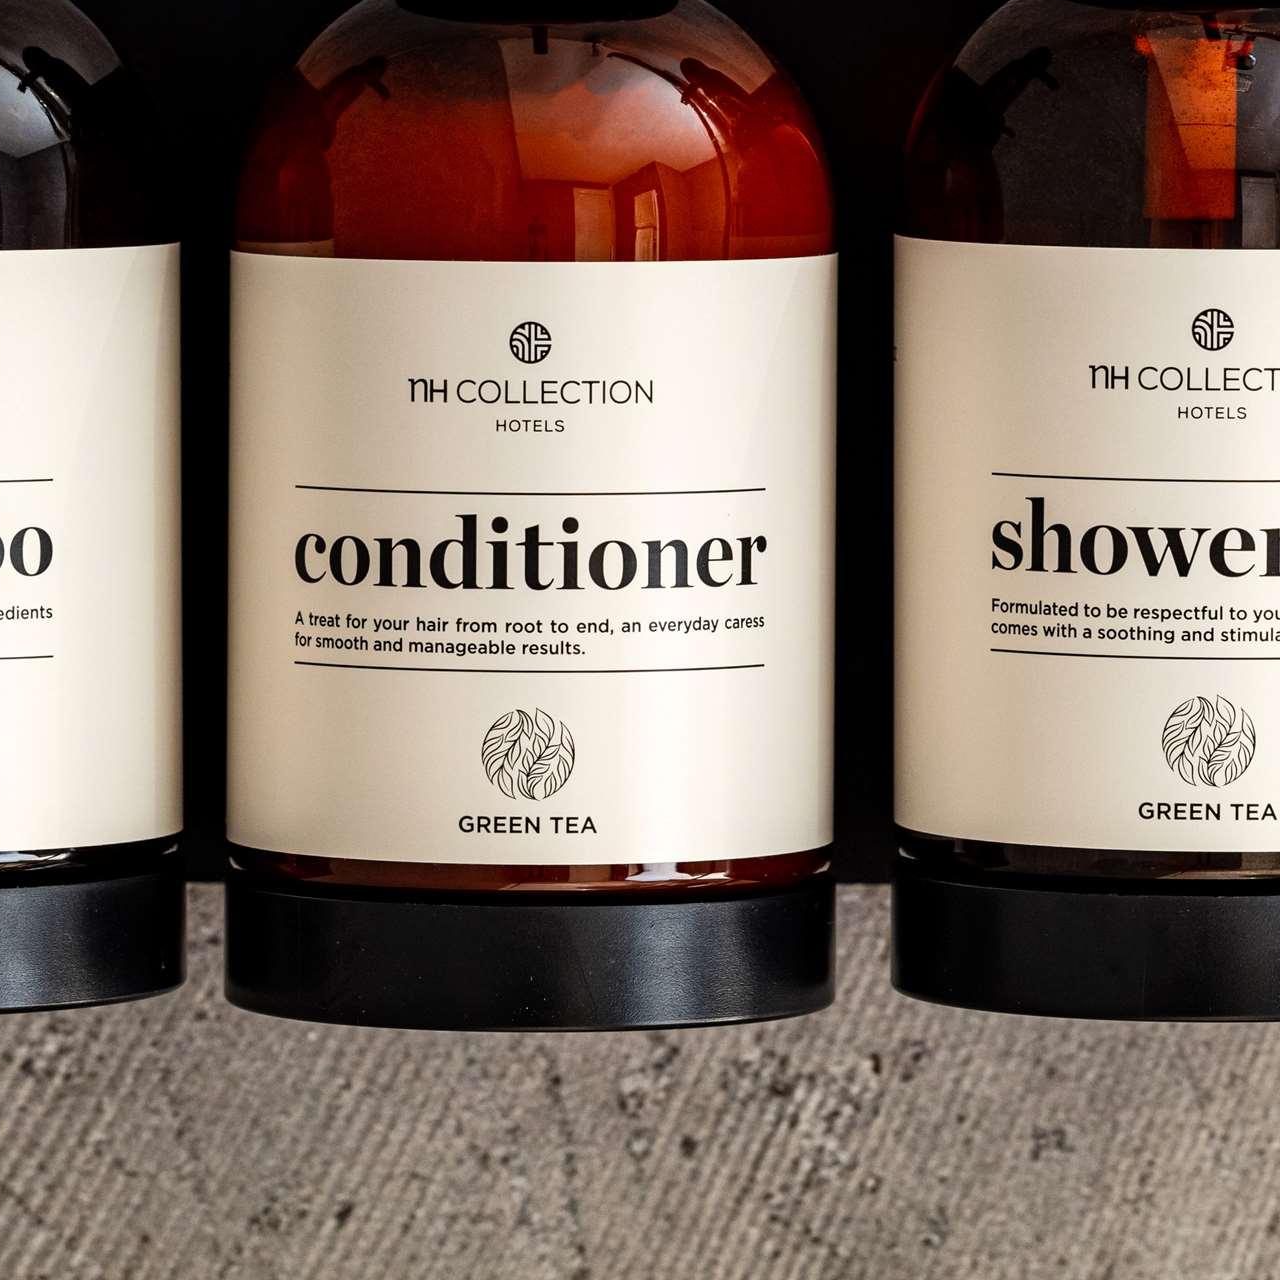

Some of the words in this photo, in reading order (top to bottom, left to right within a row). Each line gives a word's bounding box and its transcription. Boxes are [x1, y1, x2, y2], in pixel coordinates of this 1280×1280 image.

[456, 379, 653, 404] COLLECTION
[1177, 405, 1246, 419] HOTELS
[495, 418, 564, 432] HOTELS
[294, 513, 767, 591] conditioner
[991, 597, 1078, 617] Formulated
[1083, 603, 1101, 618] to
[1106, 603, 1128, 619] be
[1133, 605, 1223, 622] respectful
[1228, 606, 1247, 620] to
[294, 610, 304, 625] A
[308, 611, 340, 628] treat
[345, 613, 367, 629] for
[372, 617, 410, 632] your
[416, 616, 449, 632] hair
[455, 617, 497, 633] from
[505, 619, 542, 633] root
[549, 619, 568, 633] to
[576, 618, 613, 635] end,
[621, 621, 641, 632] an
[648, 616, 718, 634] everyday
[724, 616, 764, 629] caress
[990, 622, 1038, 636] comes
[1042, 622, 1077, 638] with
[1082, 627, 1092, 639] a
[1097, 625, 1175, 644] soothing
[1180, 626, 1214, 642] and
[294, 631, 312, 647] for
[315, 635, 368, 650] smooth
[372, 636, 402, 652] and
[408, 639, 516, 656] manageable
[521, 640, 585, 655] results.
[1138, 801, 1220, 820] GREEN
[1229, 802, 1277, 820] TEA
[458, 815, 540, 834] GREEN
[549, 816, 597, 834] TEA
